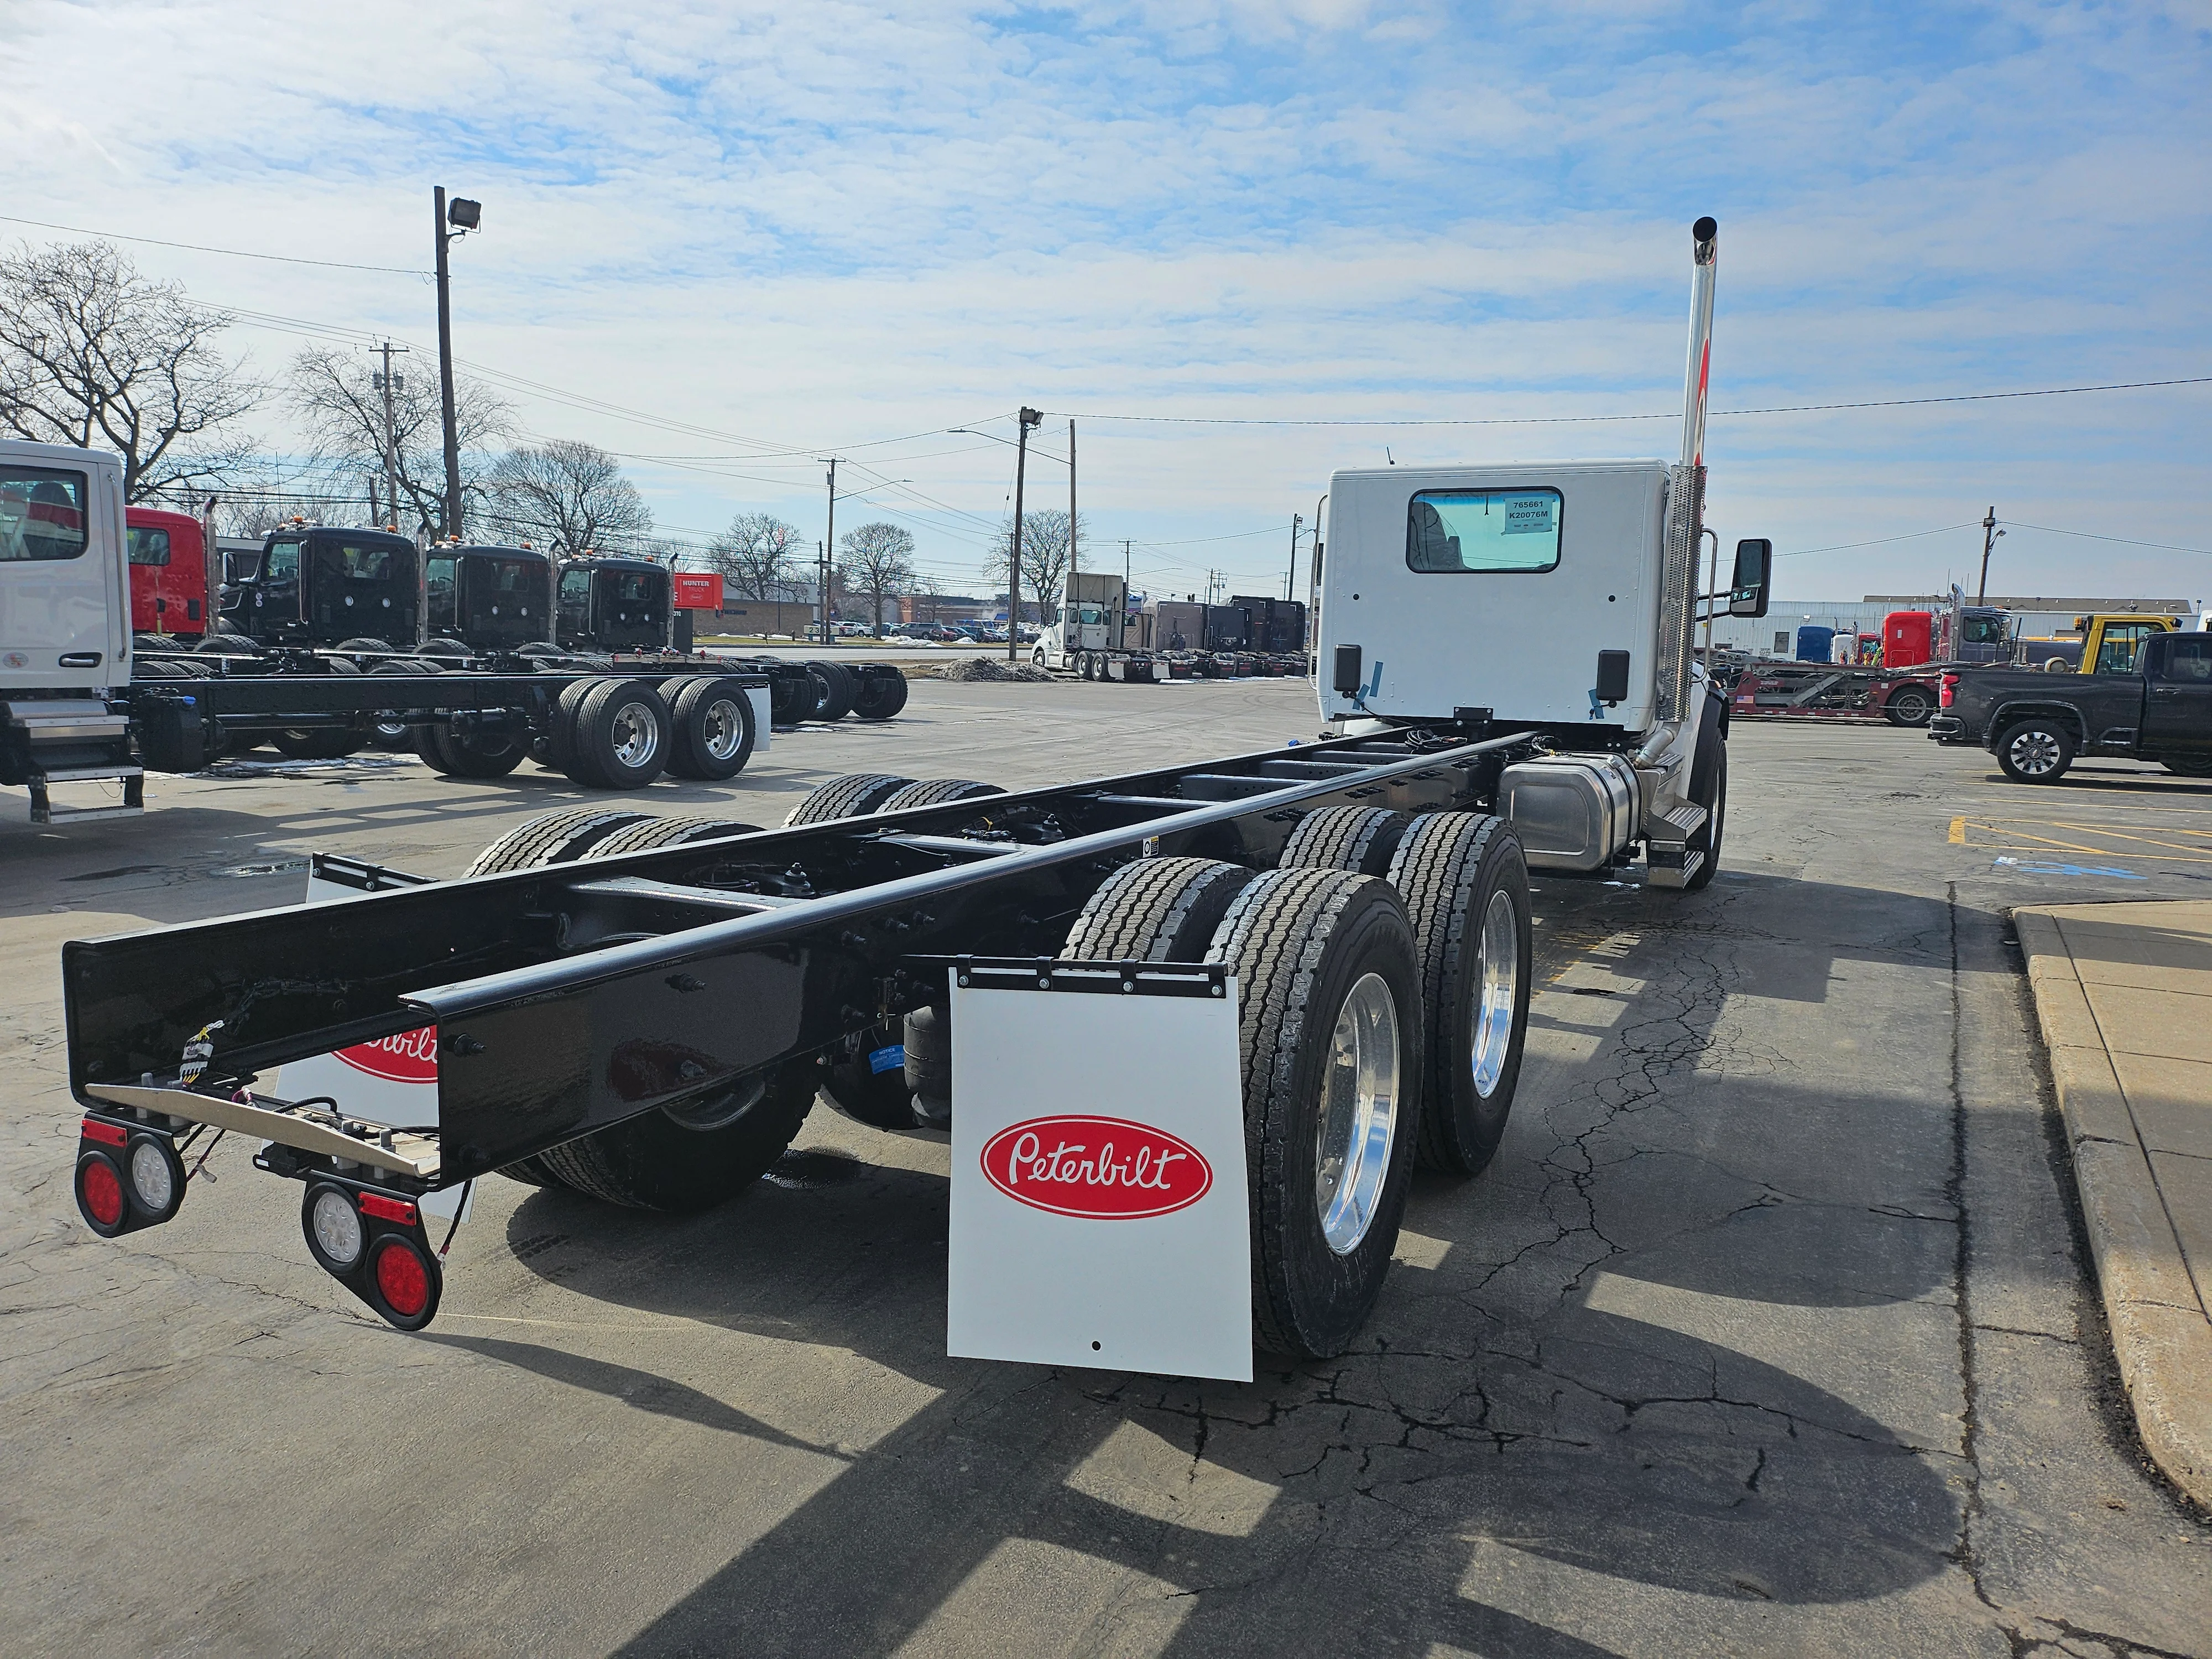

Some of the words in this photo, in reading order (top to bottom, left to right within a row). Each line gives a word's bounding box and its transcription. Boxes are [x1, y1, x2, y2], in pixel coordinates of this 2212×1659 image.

[1509, 510, 1548, 519] K20076M
[879, 1047, 896, 1056] NOTICE
[1009, 1131, 1187, 1190] Peterbilt
